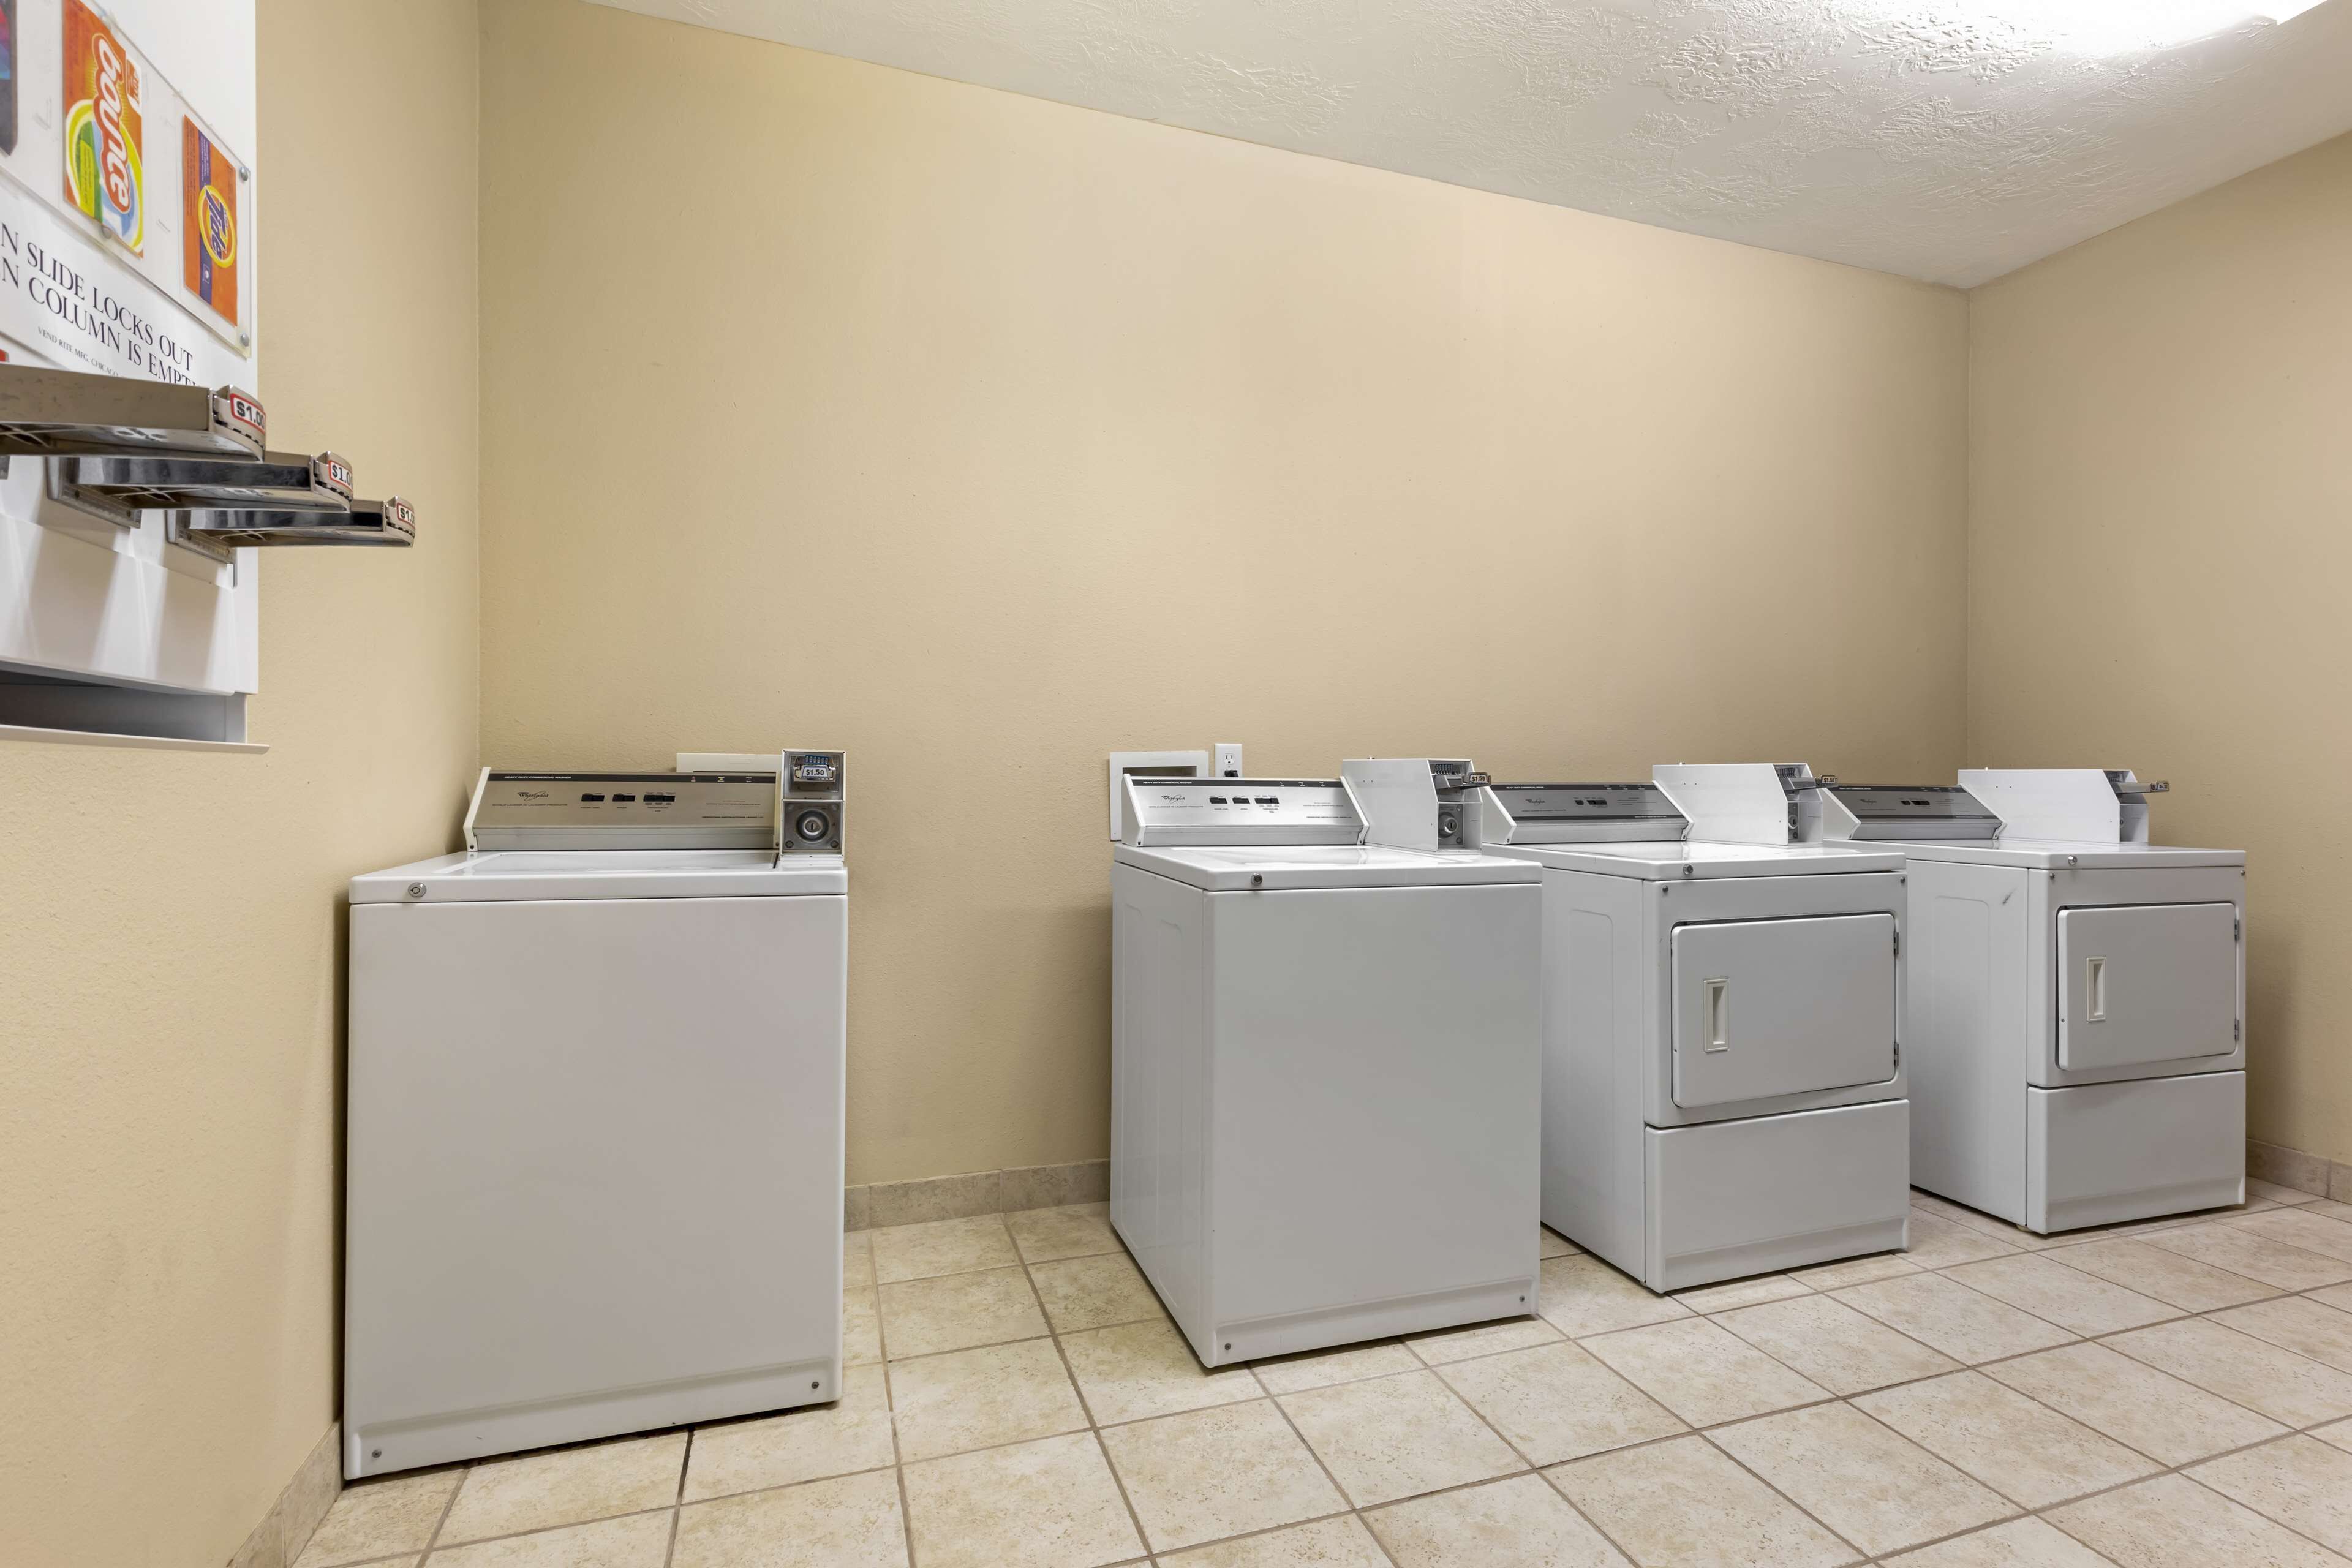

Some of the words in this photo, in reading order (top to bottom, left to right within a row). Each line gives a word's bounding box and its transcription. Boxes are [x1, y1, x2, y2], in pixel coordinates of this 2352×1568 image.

[205, 187, 227, 260] Tide
[27, 242, 85, 300] SLIDE
[93, 287, 153, 345] LOCKS
[159, 335, 192, 371] OUT
[29, 277, 120, 353] COLUMN
[128, 339, 141, 366] IS
[37, 326, 58, 344] VEND
[59, 339, 73, 353] RITE
[517, 791, 549, 801] Whirlpool
